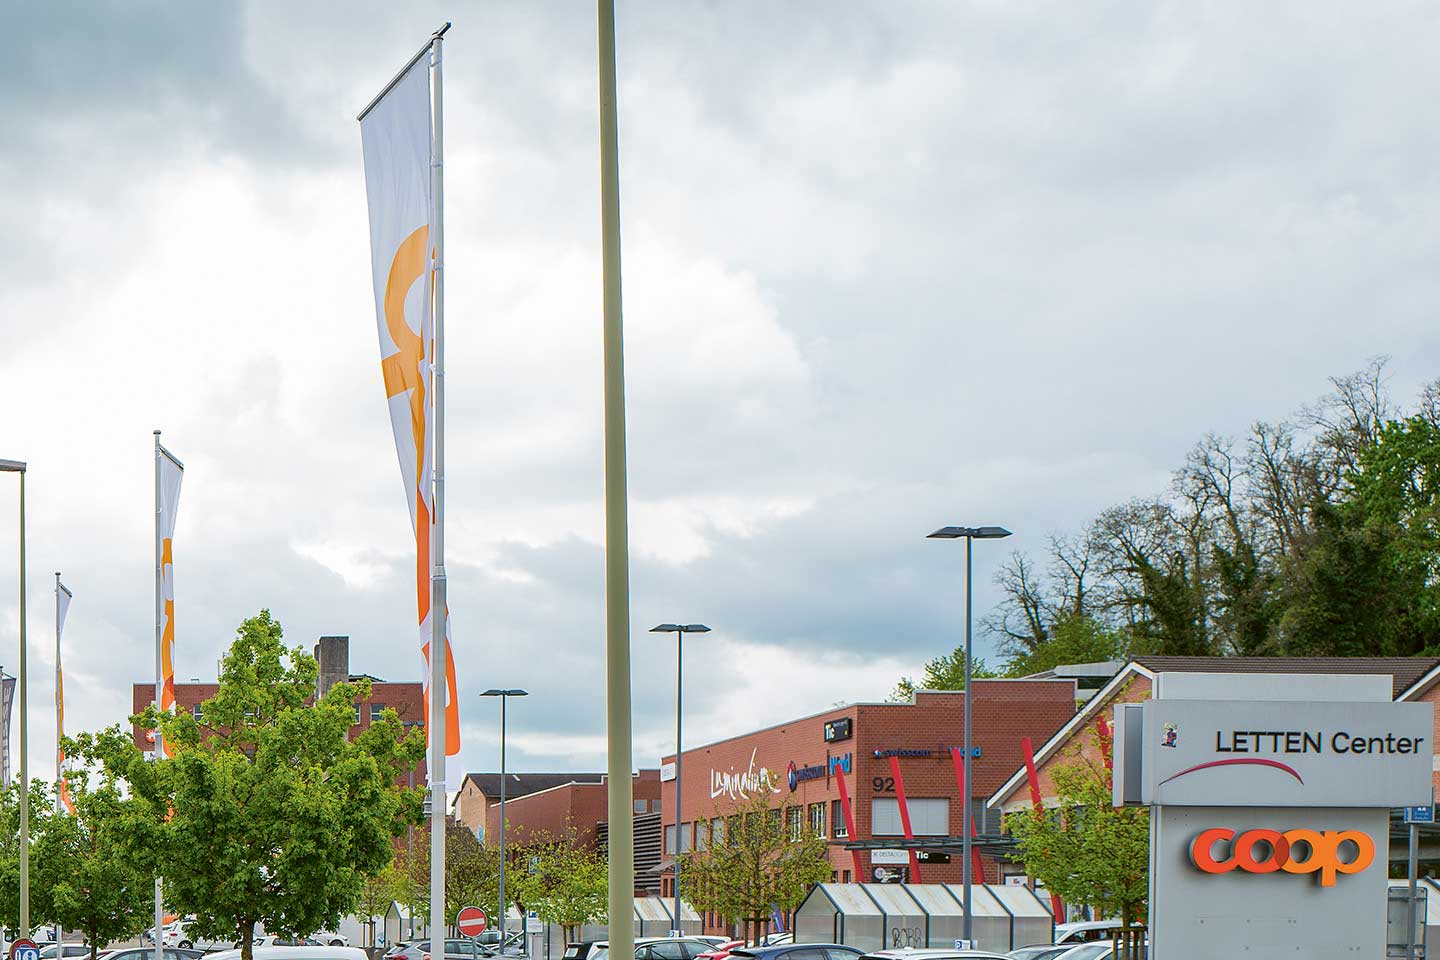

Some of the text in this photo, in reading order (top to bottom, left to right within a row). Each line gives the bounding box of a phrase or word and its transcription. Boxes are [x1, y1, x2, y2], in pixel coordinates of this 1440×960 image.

[1216, 731, 1424, 754] LETTEN Center
[872, 777, 896, 792] 92
[915, 851, 928, 859] Tic
[1192, 828, 1375, 887] coop
